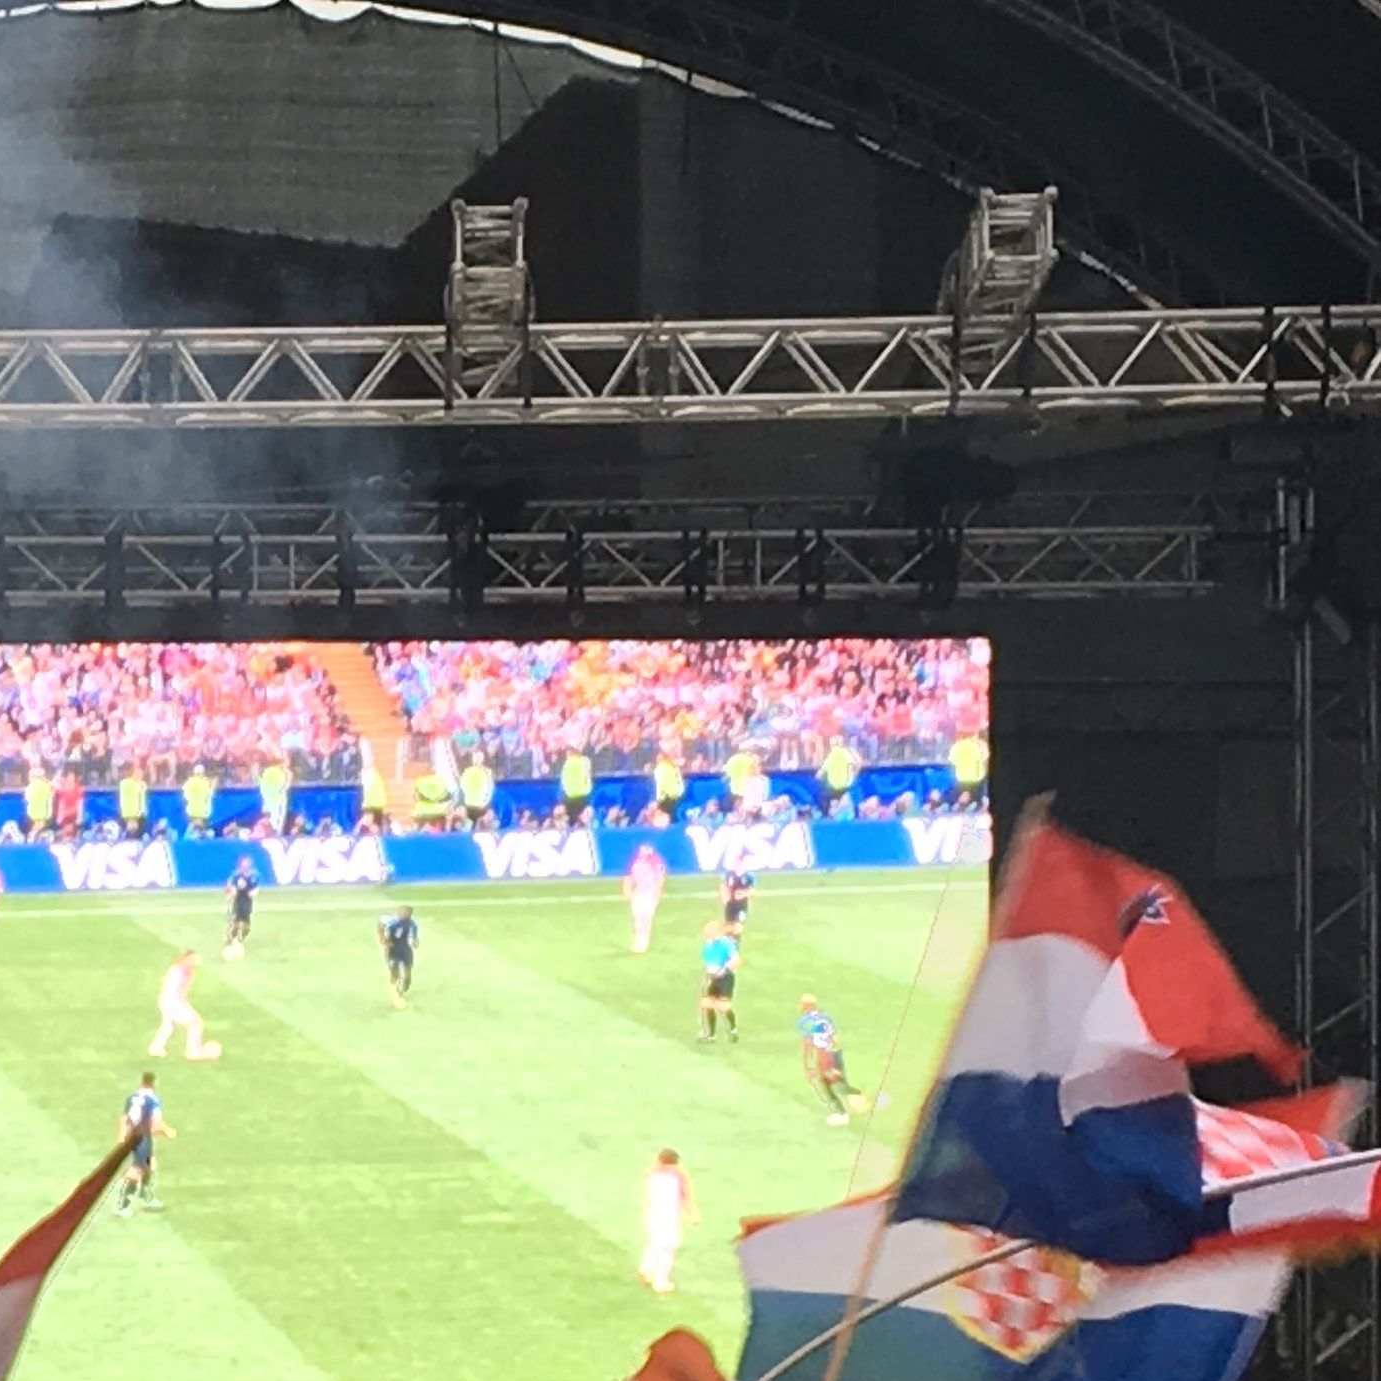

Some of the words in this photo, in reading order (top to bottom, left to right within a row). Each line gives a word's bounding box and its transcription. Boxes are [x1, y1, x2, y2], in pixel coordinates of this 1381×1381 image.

[50, 837, 177, 889] VISA
[261, 835, 387, 884] VISA
[473, 829, 599, 879] VISA
[686, 822, 814, 870] VISA
